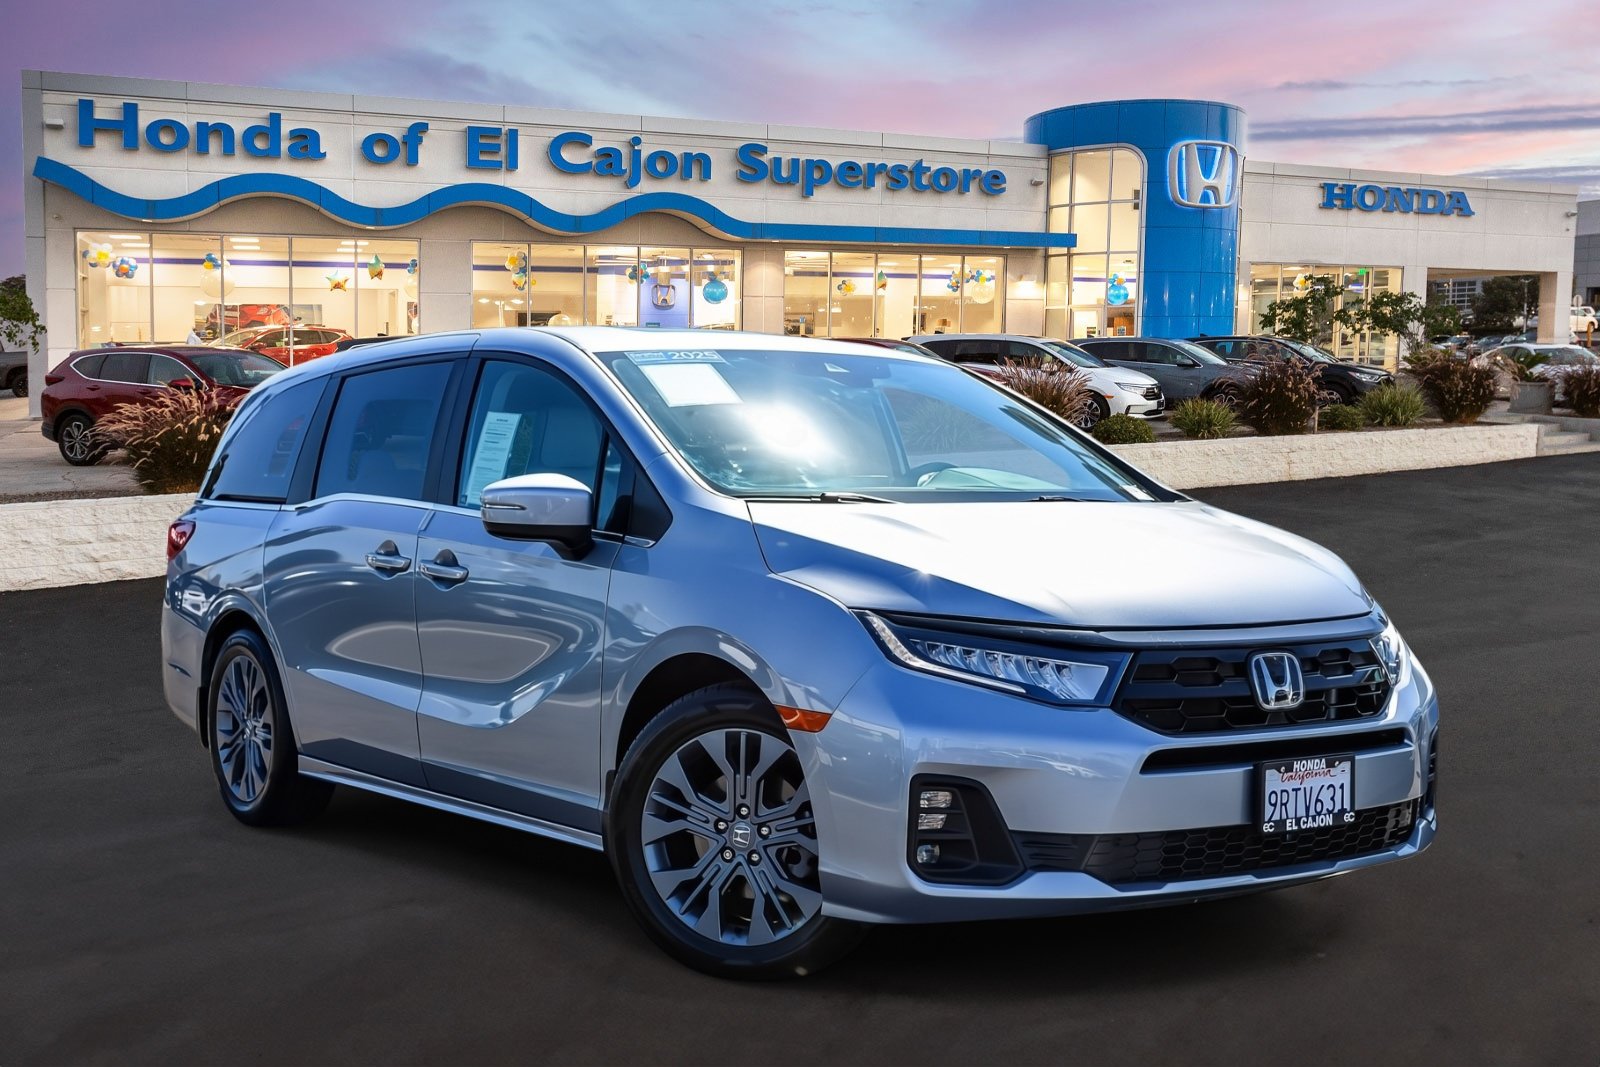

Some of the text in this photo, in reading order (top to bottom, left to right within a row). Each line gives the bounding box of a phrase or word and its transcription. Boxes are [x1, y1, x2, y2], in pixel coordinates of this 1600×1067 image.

[77, 98, 1008, 197] Honda of El Cajon Superstore
[1320, 182, 1475, 217] HONDA
[667, 351, 718, 360] 2025
[1293, 758, 1326, 772] HONDA
[1280, 768, 1336, 785] California
[1268, 782, 1347, 821] 9RTV631
[1286, 813, 1333, 831] EL CAJON
